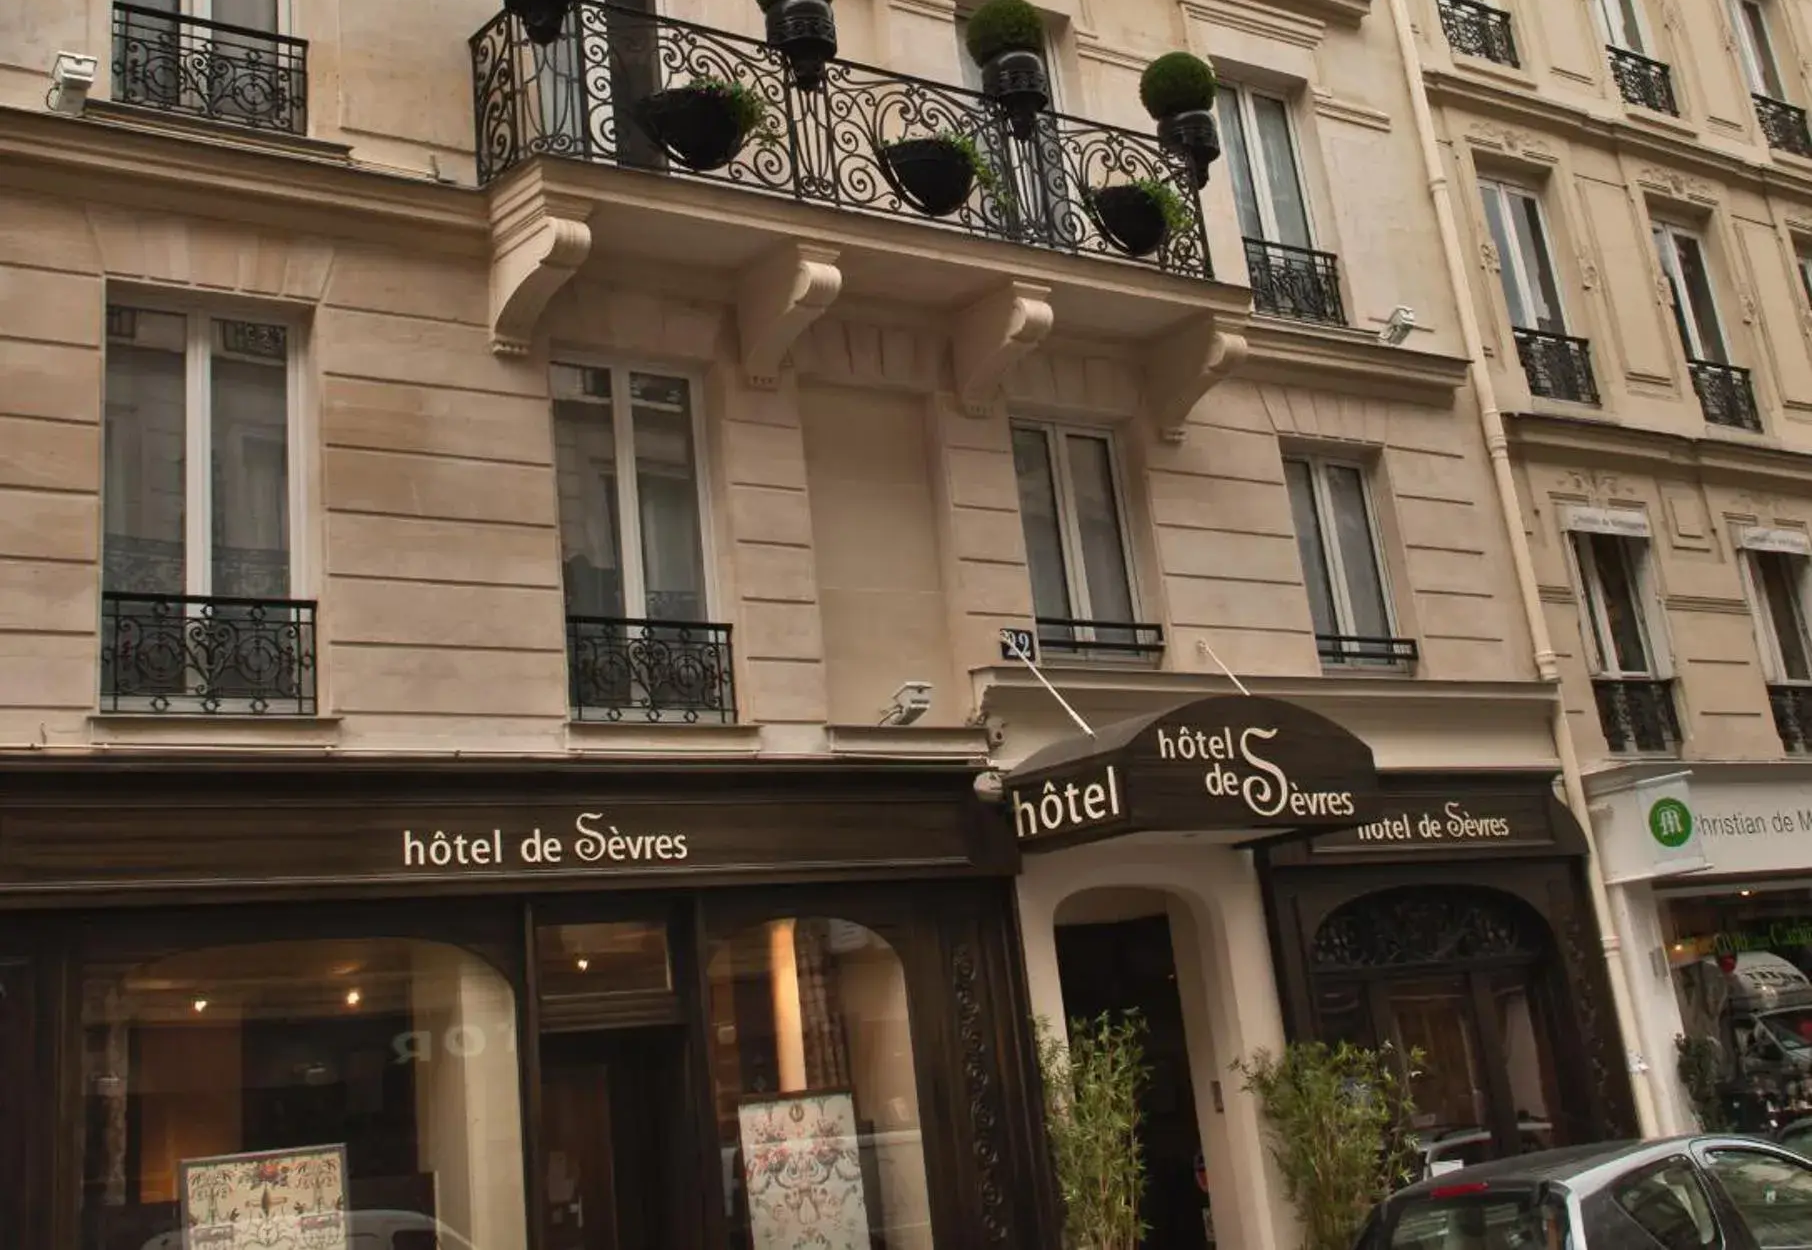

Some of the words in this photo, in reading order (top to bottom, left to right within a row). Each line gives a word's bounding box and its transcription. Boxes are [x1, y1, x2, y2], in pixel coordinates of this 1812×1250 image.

[1006, 631, 1031, 657] 22
[1157, 726, 1234, 759] hôtel
[1205, 763, 1239, 797] de
[1239, 727, 1355, 817] Sèvres
[1012, 765, 1121, 838] hôtel
[403, 829, 503, 866] hôtel
[520, 827, 563, 863] de
[574, 812, 688, 862] Sèvres
[1418, 812, 1443, 839] de
[1444, 802, 1510, 839] Sèvres
[1694, 811, 1767, 837] hristian
[1771, 809, 1795, 834] de
